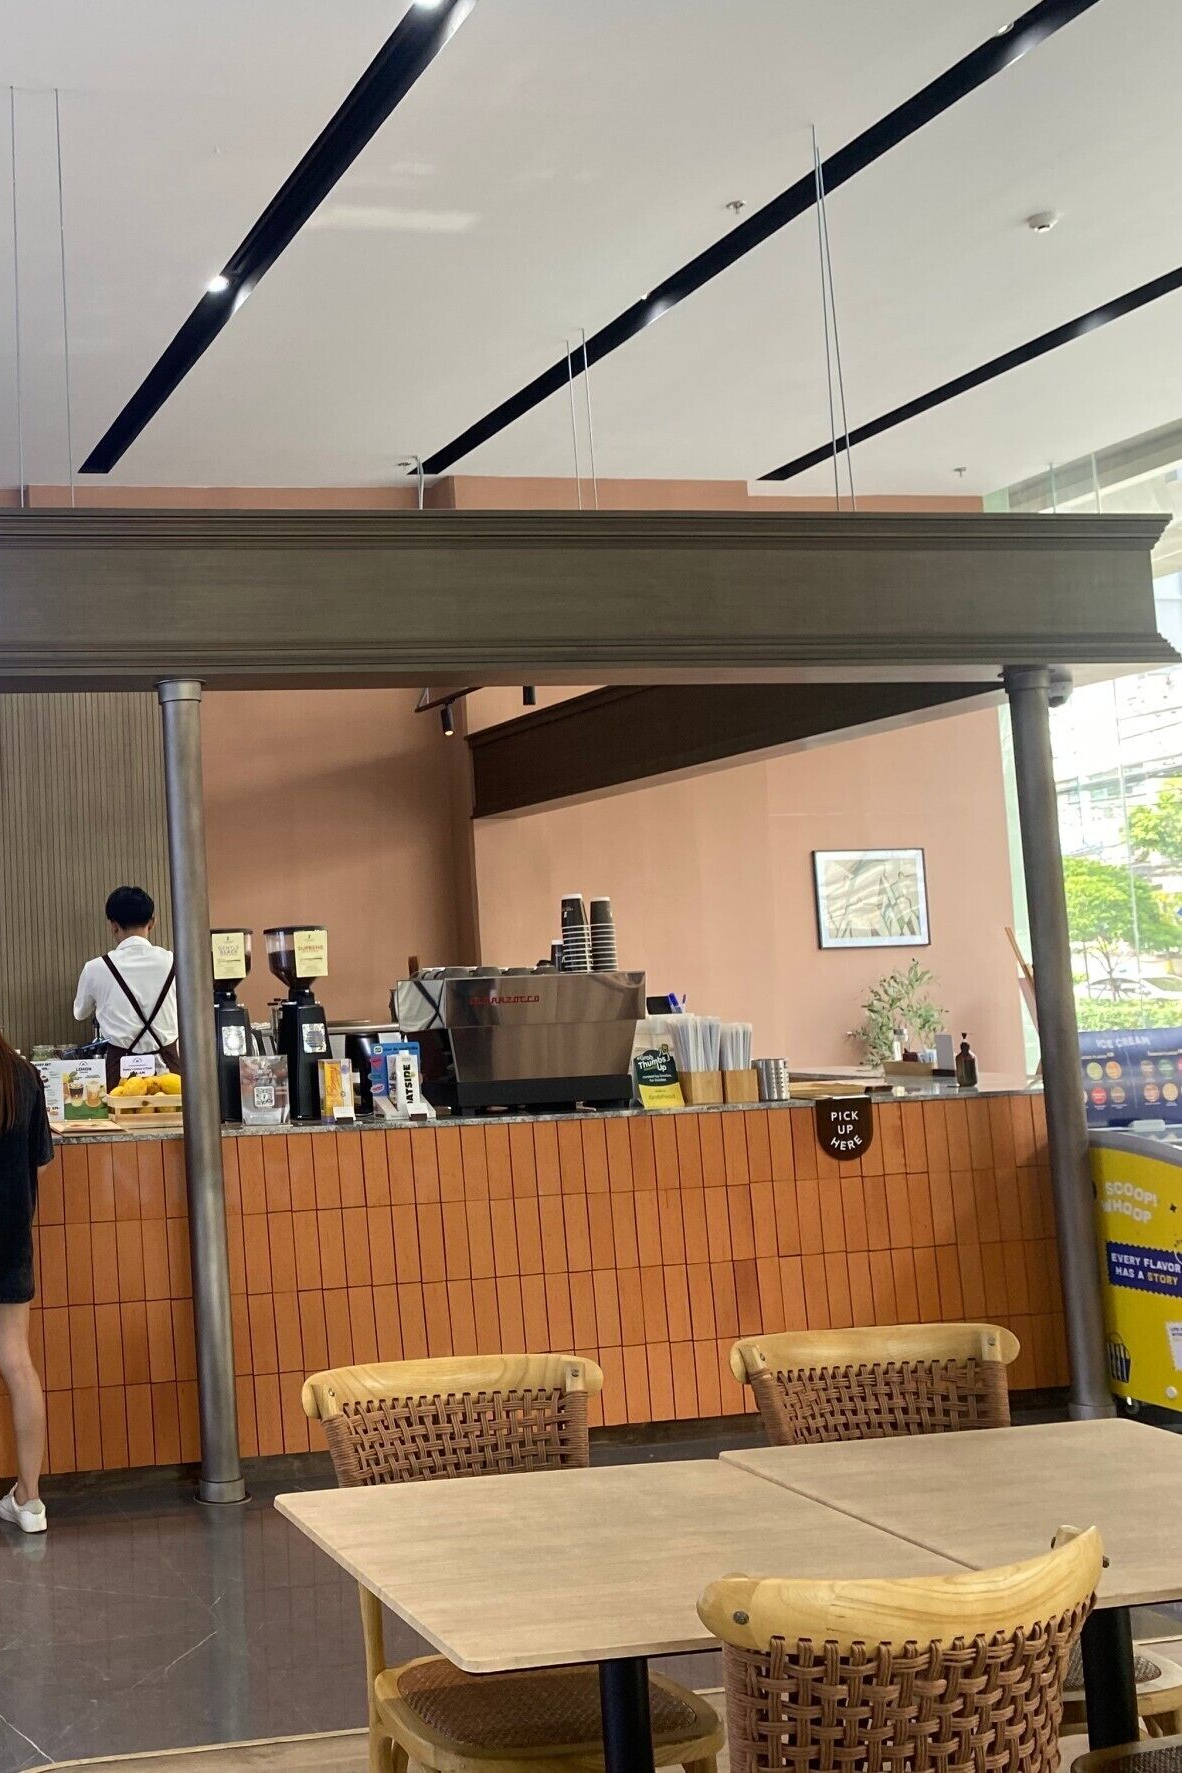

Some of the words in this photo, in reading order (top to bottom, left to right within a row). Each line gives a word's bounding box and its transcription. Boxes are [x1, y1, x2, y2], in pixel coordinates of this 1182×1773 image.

[638, 1056, 667, 1070] Thumbs
[657, 1064, 667, 1073] Up
[830, 1110, 859, 1121] PICK
[837, 1124, 853, 1135] UP
[830, 1134, 863, 1151] HERE
[1105, 1182, 1157, 1207] SCOOP!
[1111, 1252, 1141, 1266] EVERY
[1143, 1258, 1182, 1274] FLAVOR
[1115, 1266, 1135, 1278] HAS
[1137, 1270, 1145, 1280] A
[1147, 1271, 1179, 1286] STORY
